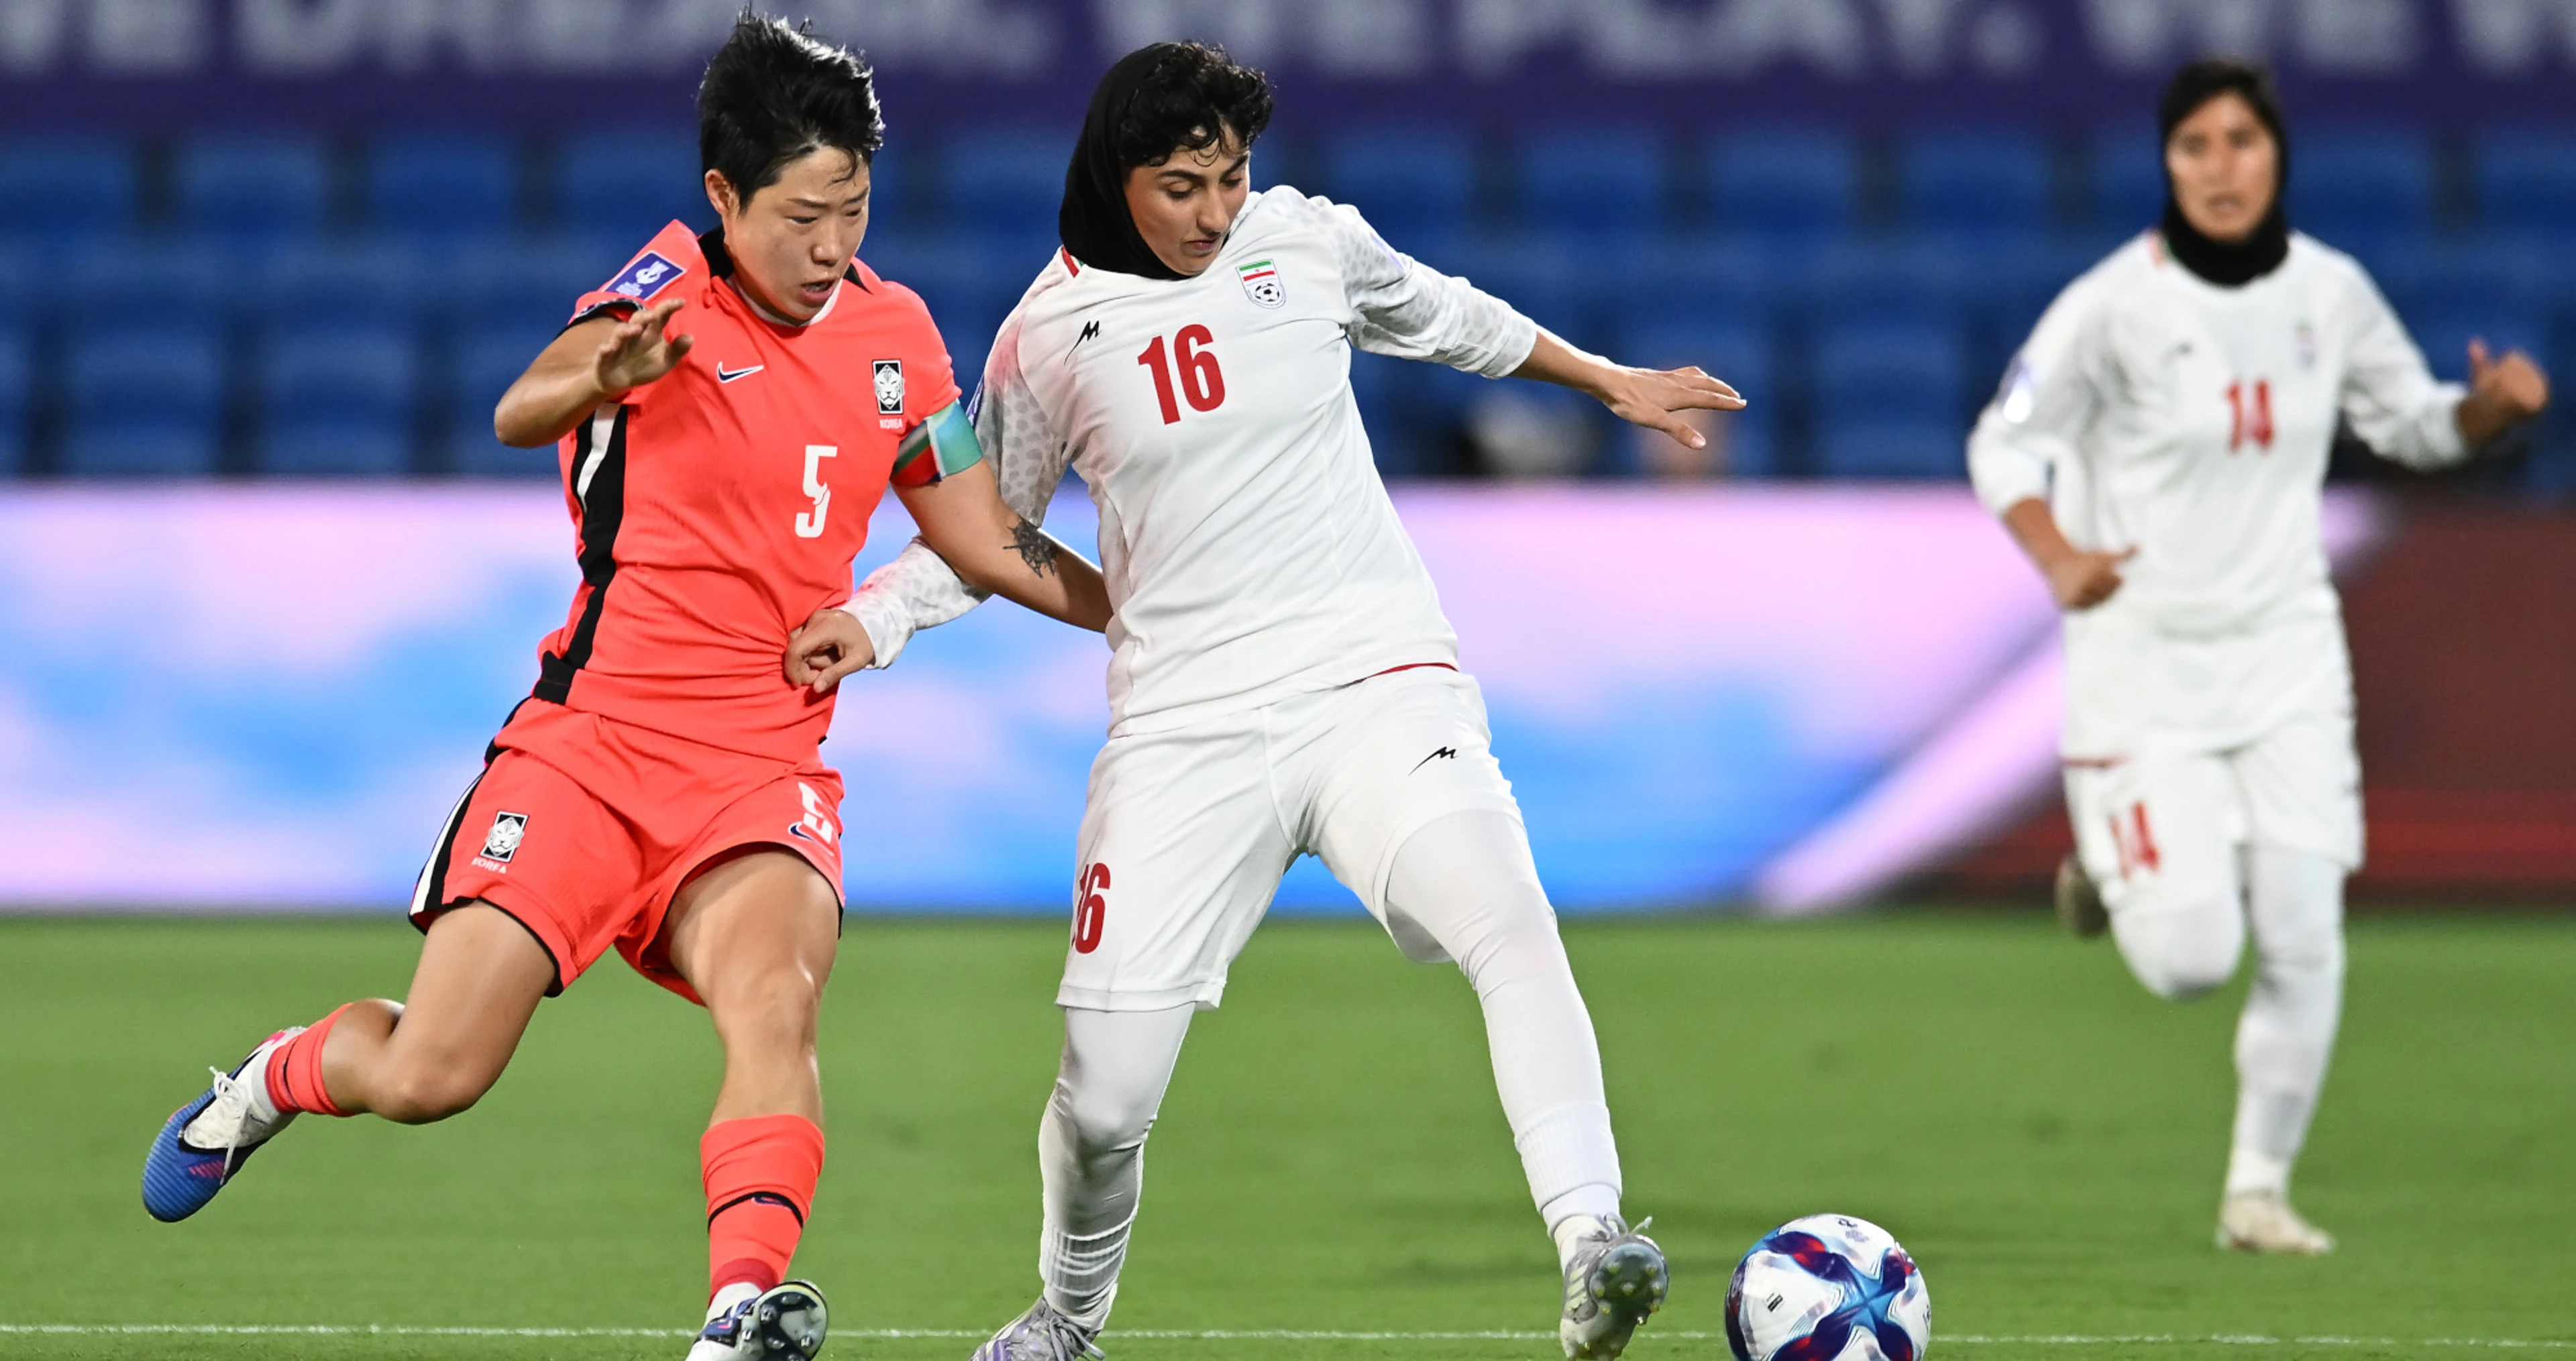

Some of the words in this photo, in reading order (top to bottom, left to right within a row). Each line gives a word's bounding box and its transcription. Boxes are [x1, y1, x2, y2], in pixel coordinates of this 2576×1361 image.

[1138, 324, 1226, 425] 16
[2224, 378, 2273, 454] 14
[795, 445, 838, 538] 5
[798, 781, 834, 844] 5
